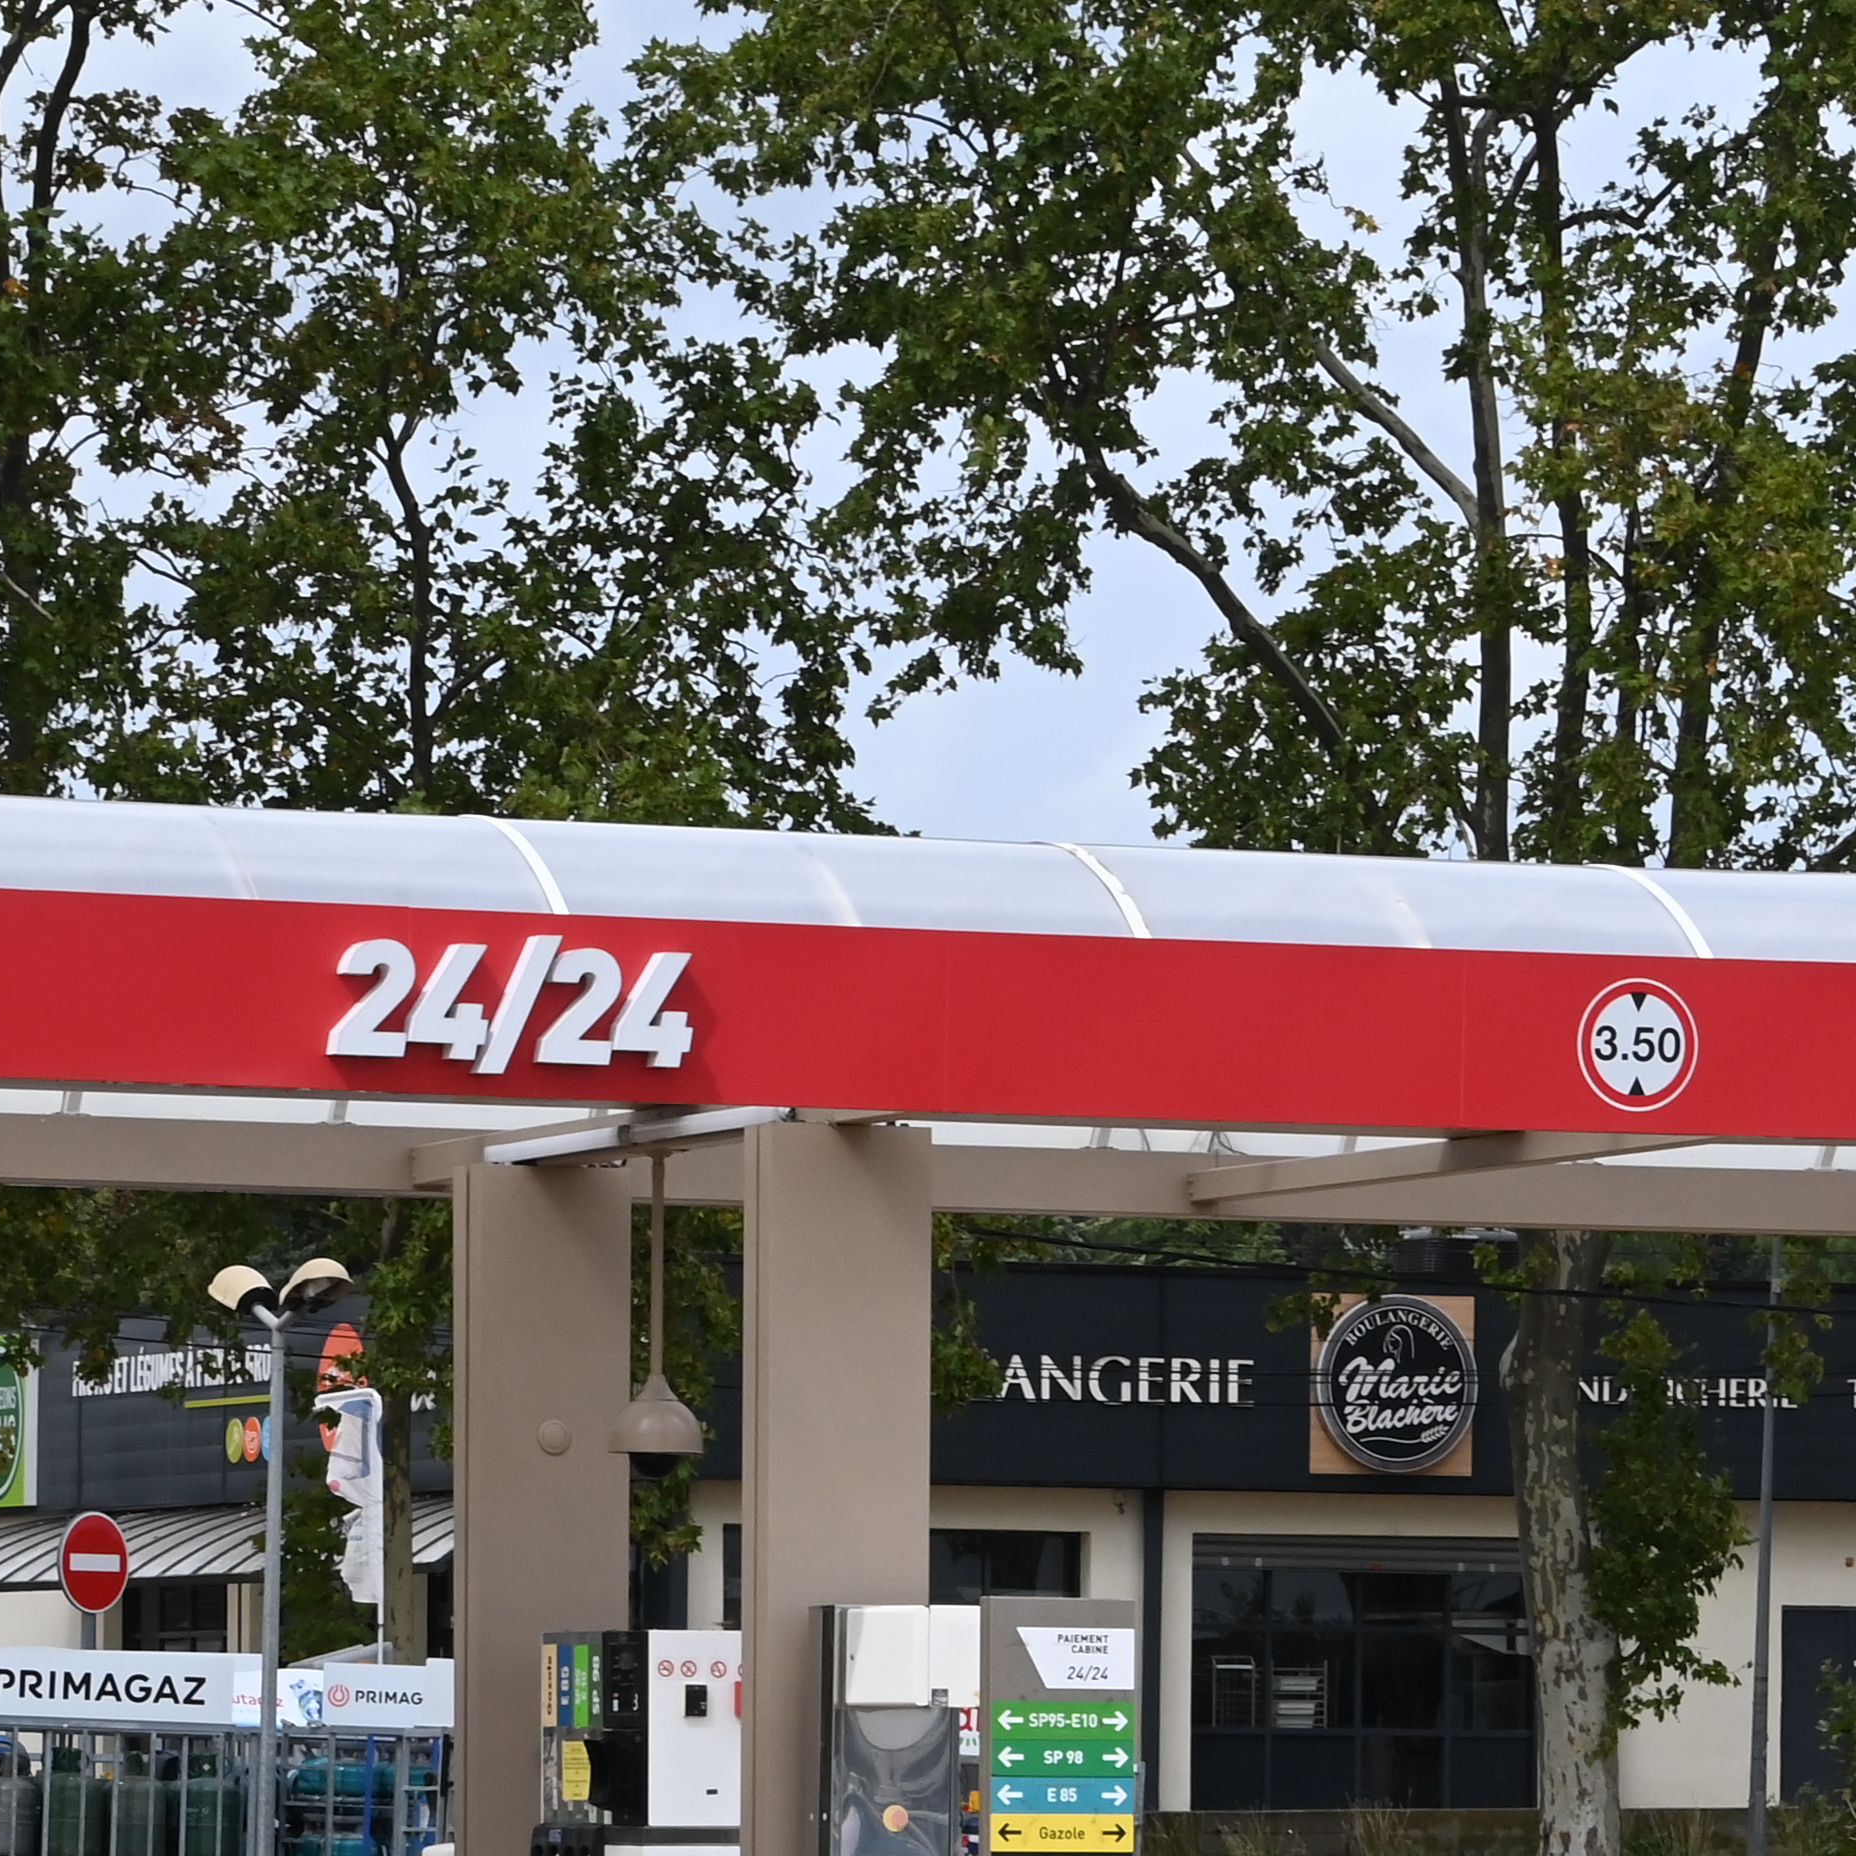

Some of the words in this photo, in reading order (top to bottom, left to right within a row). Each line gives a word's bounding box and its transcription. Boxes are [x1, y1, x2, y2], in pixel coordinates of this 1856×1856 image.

[326, 935, 693, 1074] 24/24
[1594, 1025, 1681, 1063] 3.50
[1344, 1310, 1454, 1350] BOULANGERIE
[114, 1356, 129, 1393] ET
[130, 1346, 185, 1392] LÉGUMES
[1338, 1356, 1462, 1402] Marie
[1343, 1398, 1459, 1434] Blachère
[1057, 1634, 1109, 1644] PAIEMENT
[1071, 1645, 1109, 1655] CABINE
[1067, 1666, 1109, 1681] 24/24
[355, 1690, 424, 1706] PRIMAG
[1028, 1713, 1099, 1729] SP95-E10
[1043, 1750, 1064, 1765] SP
[1066, 1750, 1084, 1765] 98
[1047, 1787, 1057, 1802] E
[1059, 1787, 1078, 1802] 85
[1039, 1826, 1085, 1840] Gazole
